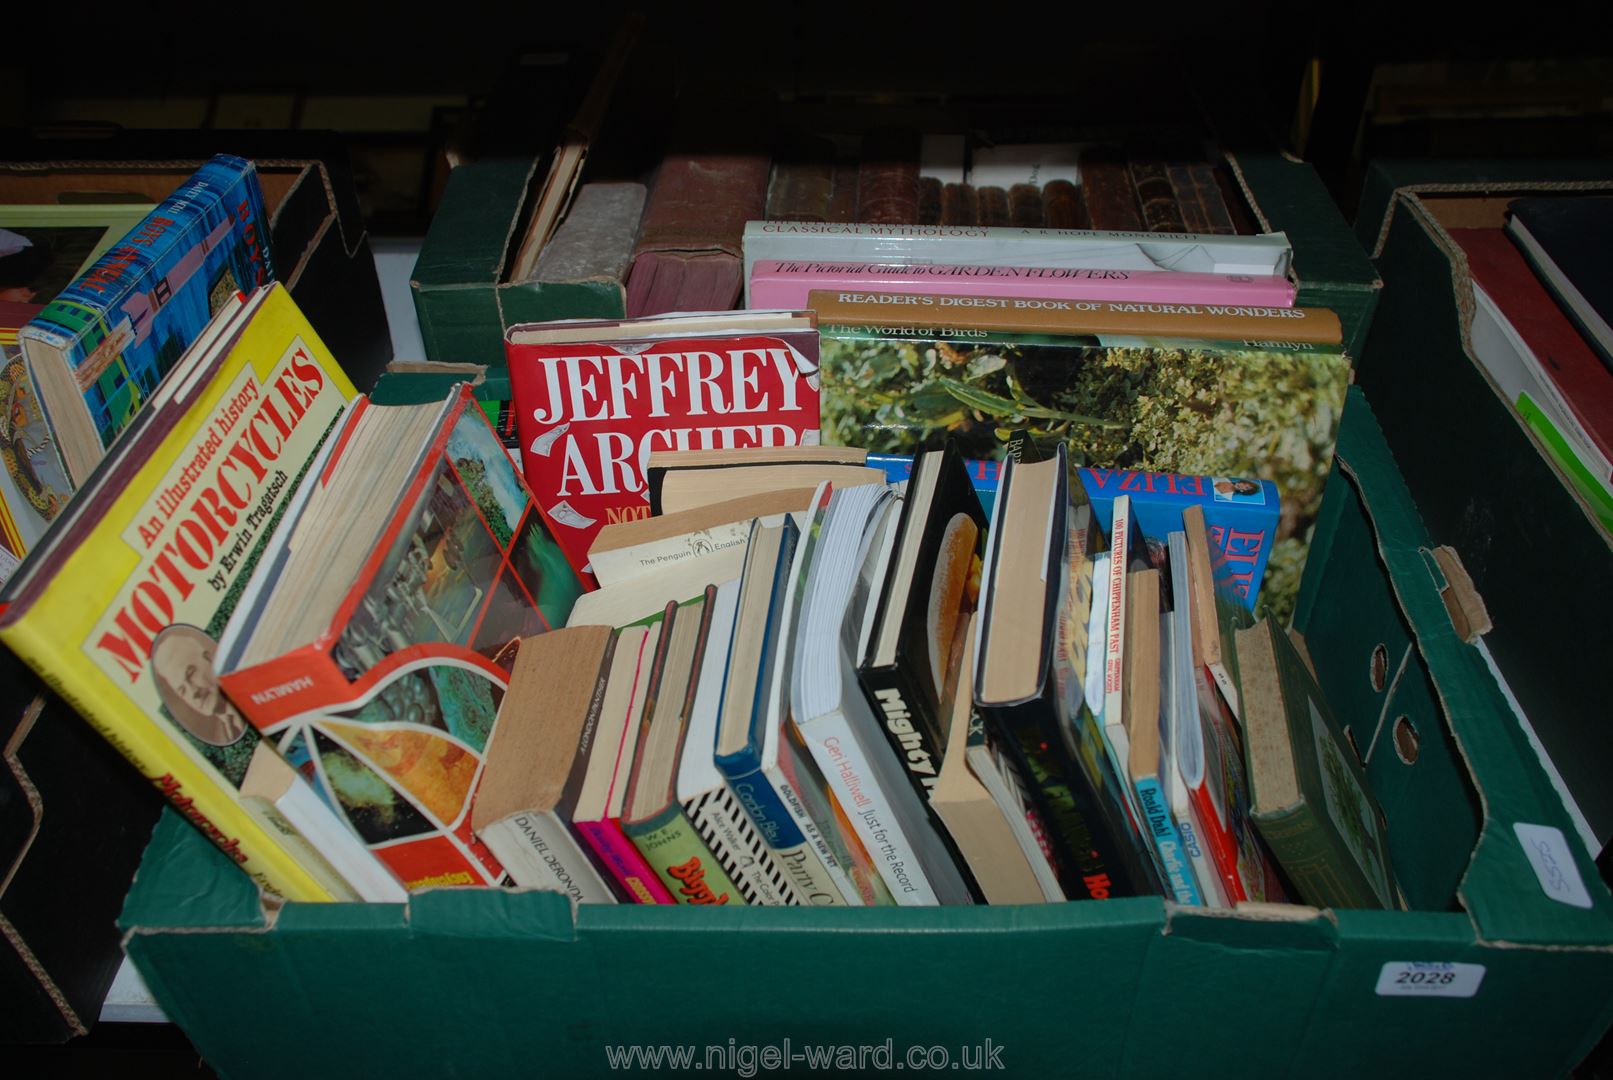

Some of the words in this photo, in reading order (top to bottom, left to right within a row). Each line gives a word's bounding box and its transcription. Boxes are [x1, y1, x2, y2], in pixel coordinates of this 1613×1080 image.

[130, 216, 176, 248] BOYS
[762, 224, 864, 235] CLASSICAL
[869, 227, 991, 238] MYTHOLOGY
[775, 262, 804, 273] The
[804, 263, 865, 275] Pictorial
[928, 264, 1024, 279] GARDEN
[1024, 267, 1131, 281] FLOWERS
[838, 293, 934, 306] READER'S
[939, 296, 1010, 309] DIGEST
[1014, 299, 1072, 311] BOOK
[1075, 301, 1103, 312] OF
[1108, 303, 1204, 315] NATURAL
[1205, 305, 1307, 319] WONDERS
[826, 324, 862, 335] The
[863, 326, 916, 337] World
[917, 327, 937, 337] of
[939, 327, 988, 339] Birds
[1243, 339, 1314, 352] Hamlyn
[533, 348, 803, 425] JEFFREY
[137, 518, 165, 551] An
[155, 428, 224, 523] illustrated
[219, 375, 261, 438] history
[96, 346, 324, 684] MOTORCYCLES
[206, 572, 229, 592] by
[218, 524, 253, 573] Erwin
[245, 467, 290, 529] Tragatsch
[1114, 517, 1126, 529] 100
[640, 558, 656, 568] The
[656, 549, 692, 566] Penguin
[713, 537, 747, 552] English
[1112, 528, 1125, 566] PICTURES
[1111, 565, 1123, 578] OF
[1109, 576, 1123, 631] CHIPPENHAM
[1108, 630, 1121, 654] PAST
[250, 675, 315, 706] HAMLYN
[873, 687, 938, 776] Mighty
[823, 735, 845, 761] Geri
[838, 757, 874, 809] Halliwell
[735, 782, 769, 824] Cordon
[1140, 787, 1161, 815] Roald
[150, 771, 249, 865] Motorcycles
[711, 811, 726, 830] Alice
[721, 825, 742, 852] Walker
[857, 809, 882, 830] Just
[1150, 811, 1172, 838] Dahl
[645, 829, 682, 851] JOHNS
[871, 827, 889, 846] for
[880, 842, 899, 862] the
[1180, 821, 1201, 858] CASIO
[514, 815, 547, 856] DANIEL
[543, 854, 584, 902] DERONDA
[779, 849, 818, 892] Party
[750, 870, 764, 884] The
[889, 857, 919, 894] Record
[1394, 971, 1456, 985] 2028
